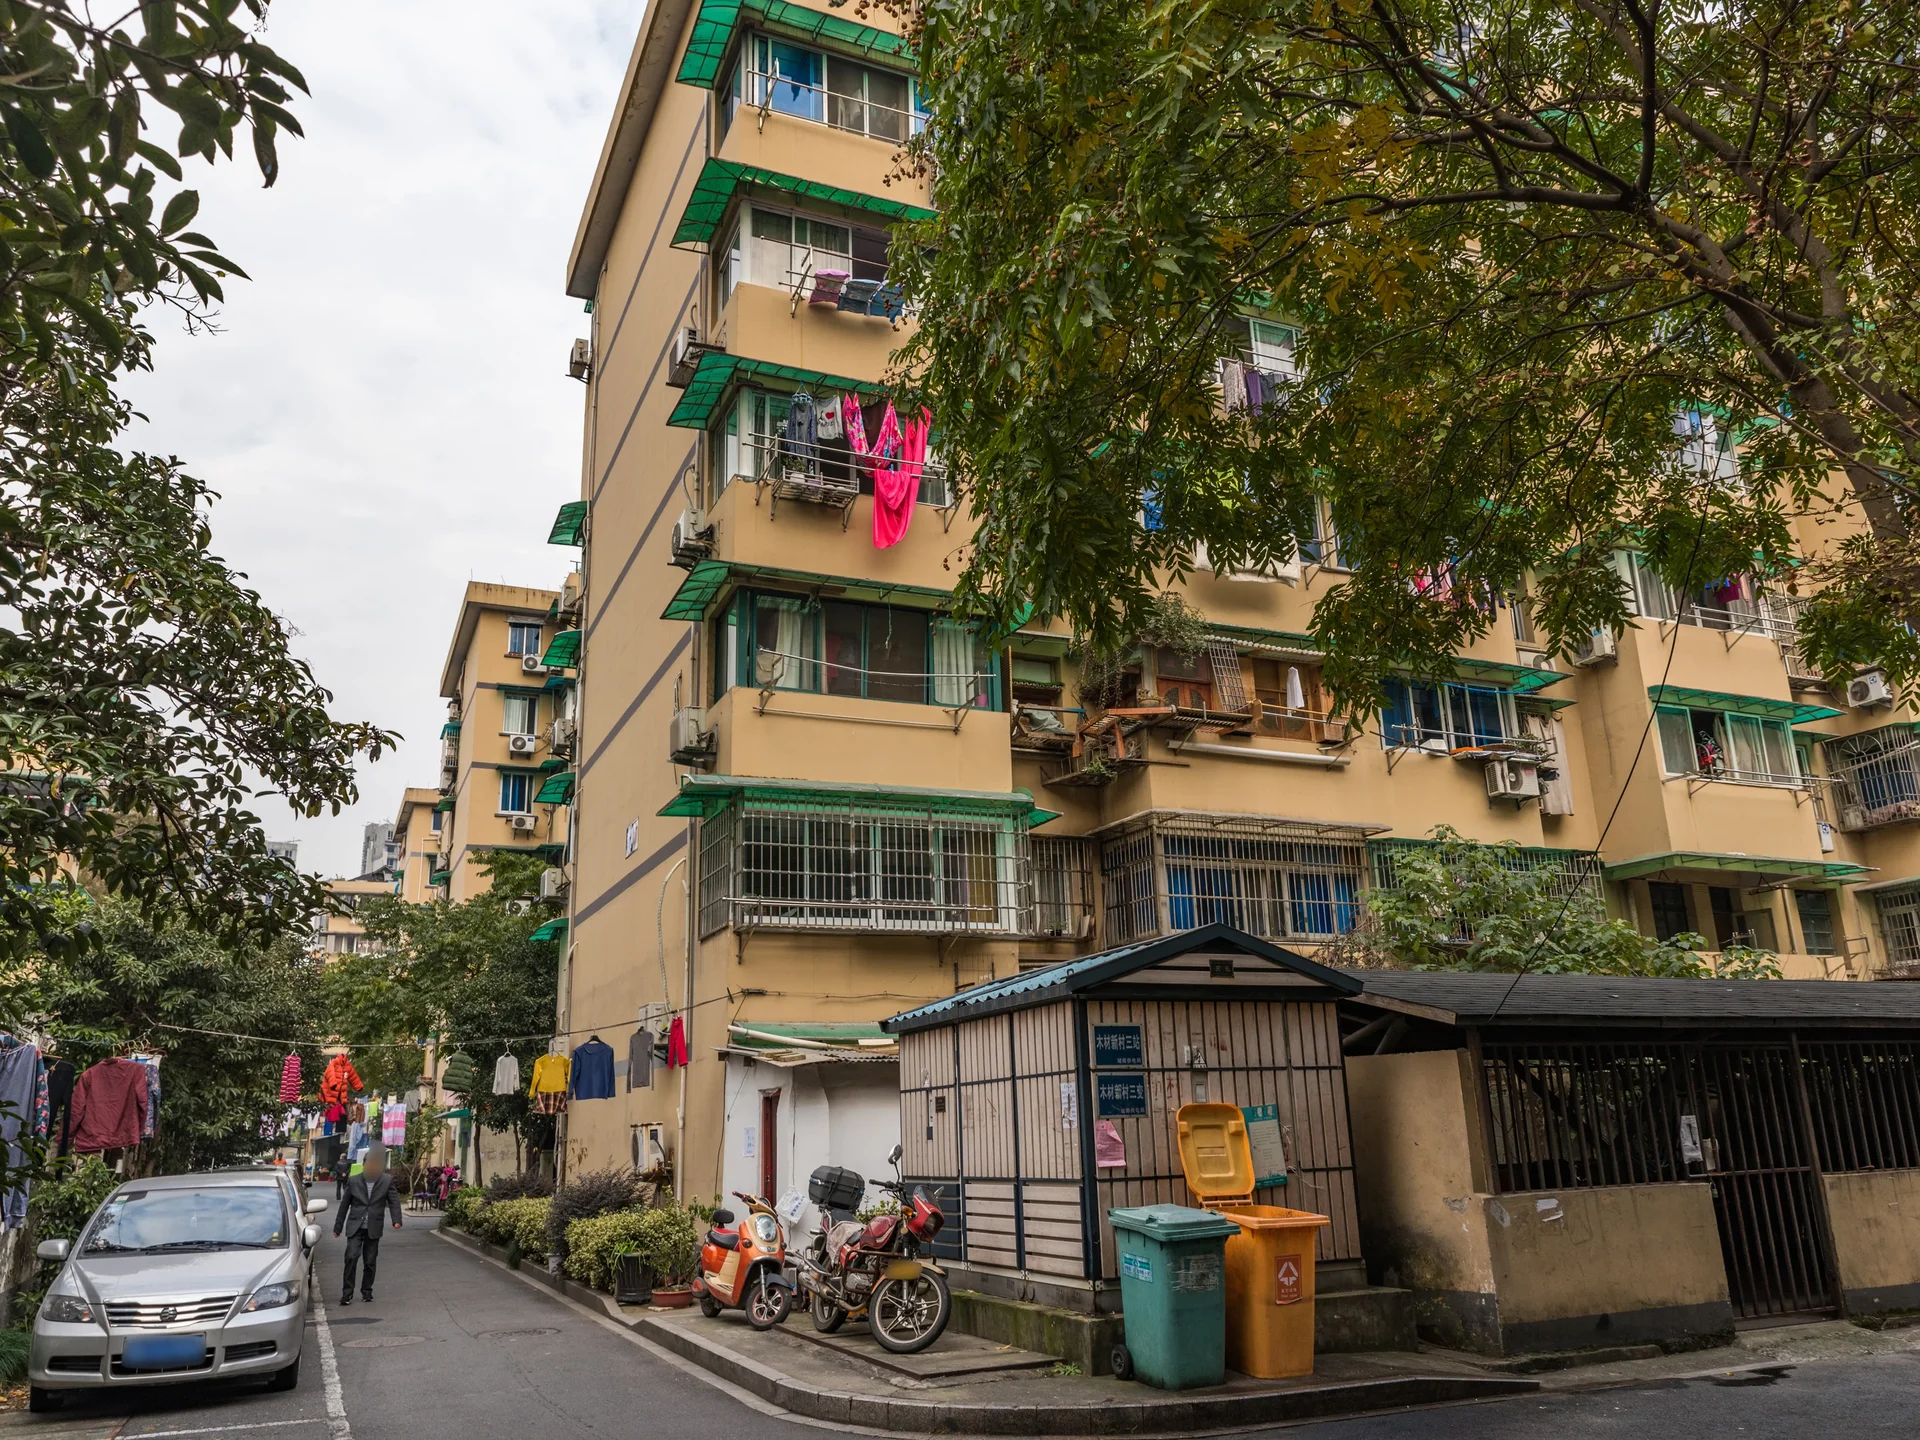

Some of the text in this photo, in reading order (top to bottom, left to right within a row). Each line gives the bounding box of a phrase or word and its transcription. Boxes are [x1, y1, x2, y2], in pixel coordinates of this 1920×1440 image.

[1096, 1034, 1140, 1050] 木材新村三站
[1099, 1083, 1144, 1100] 木材新村三变
